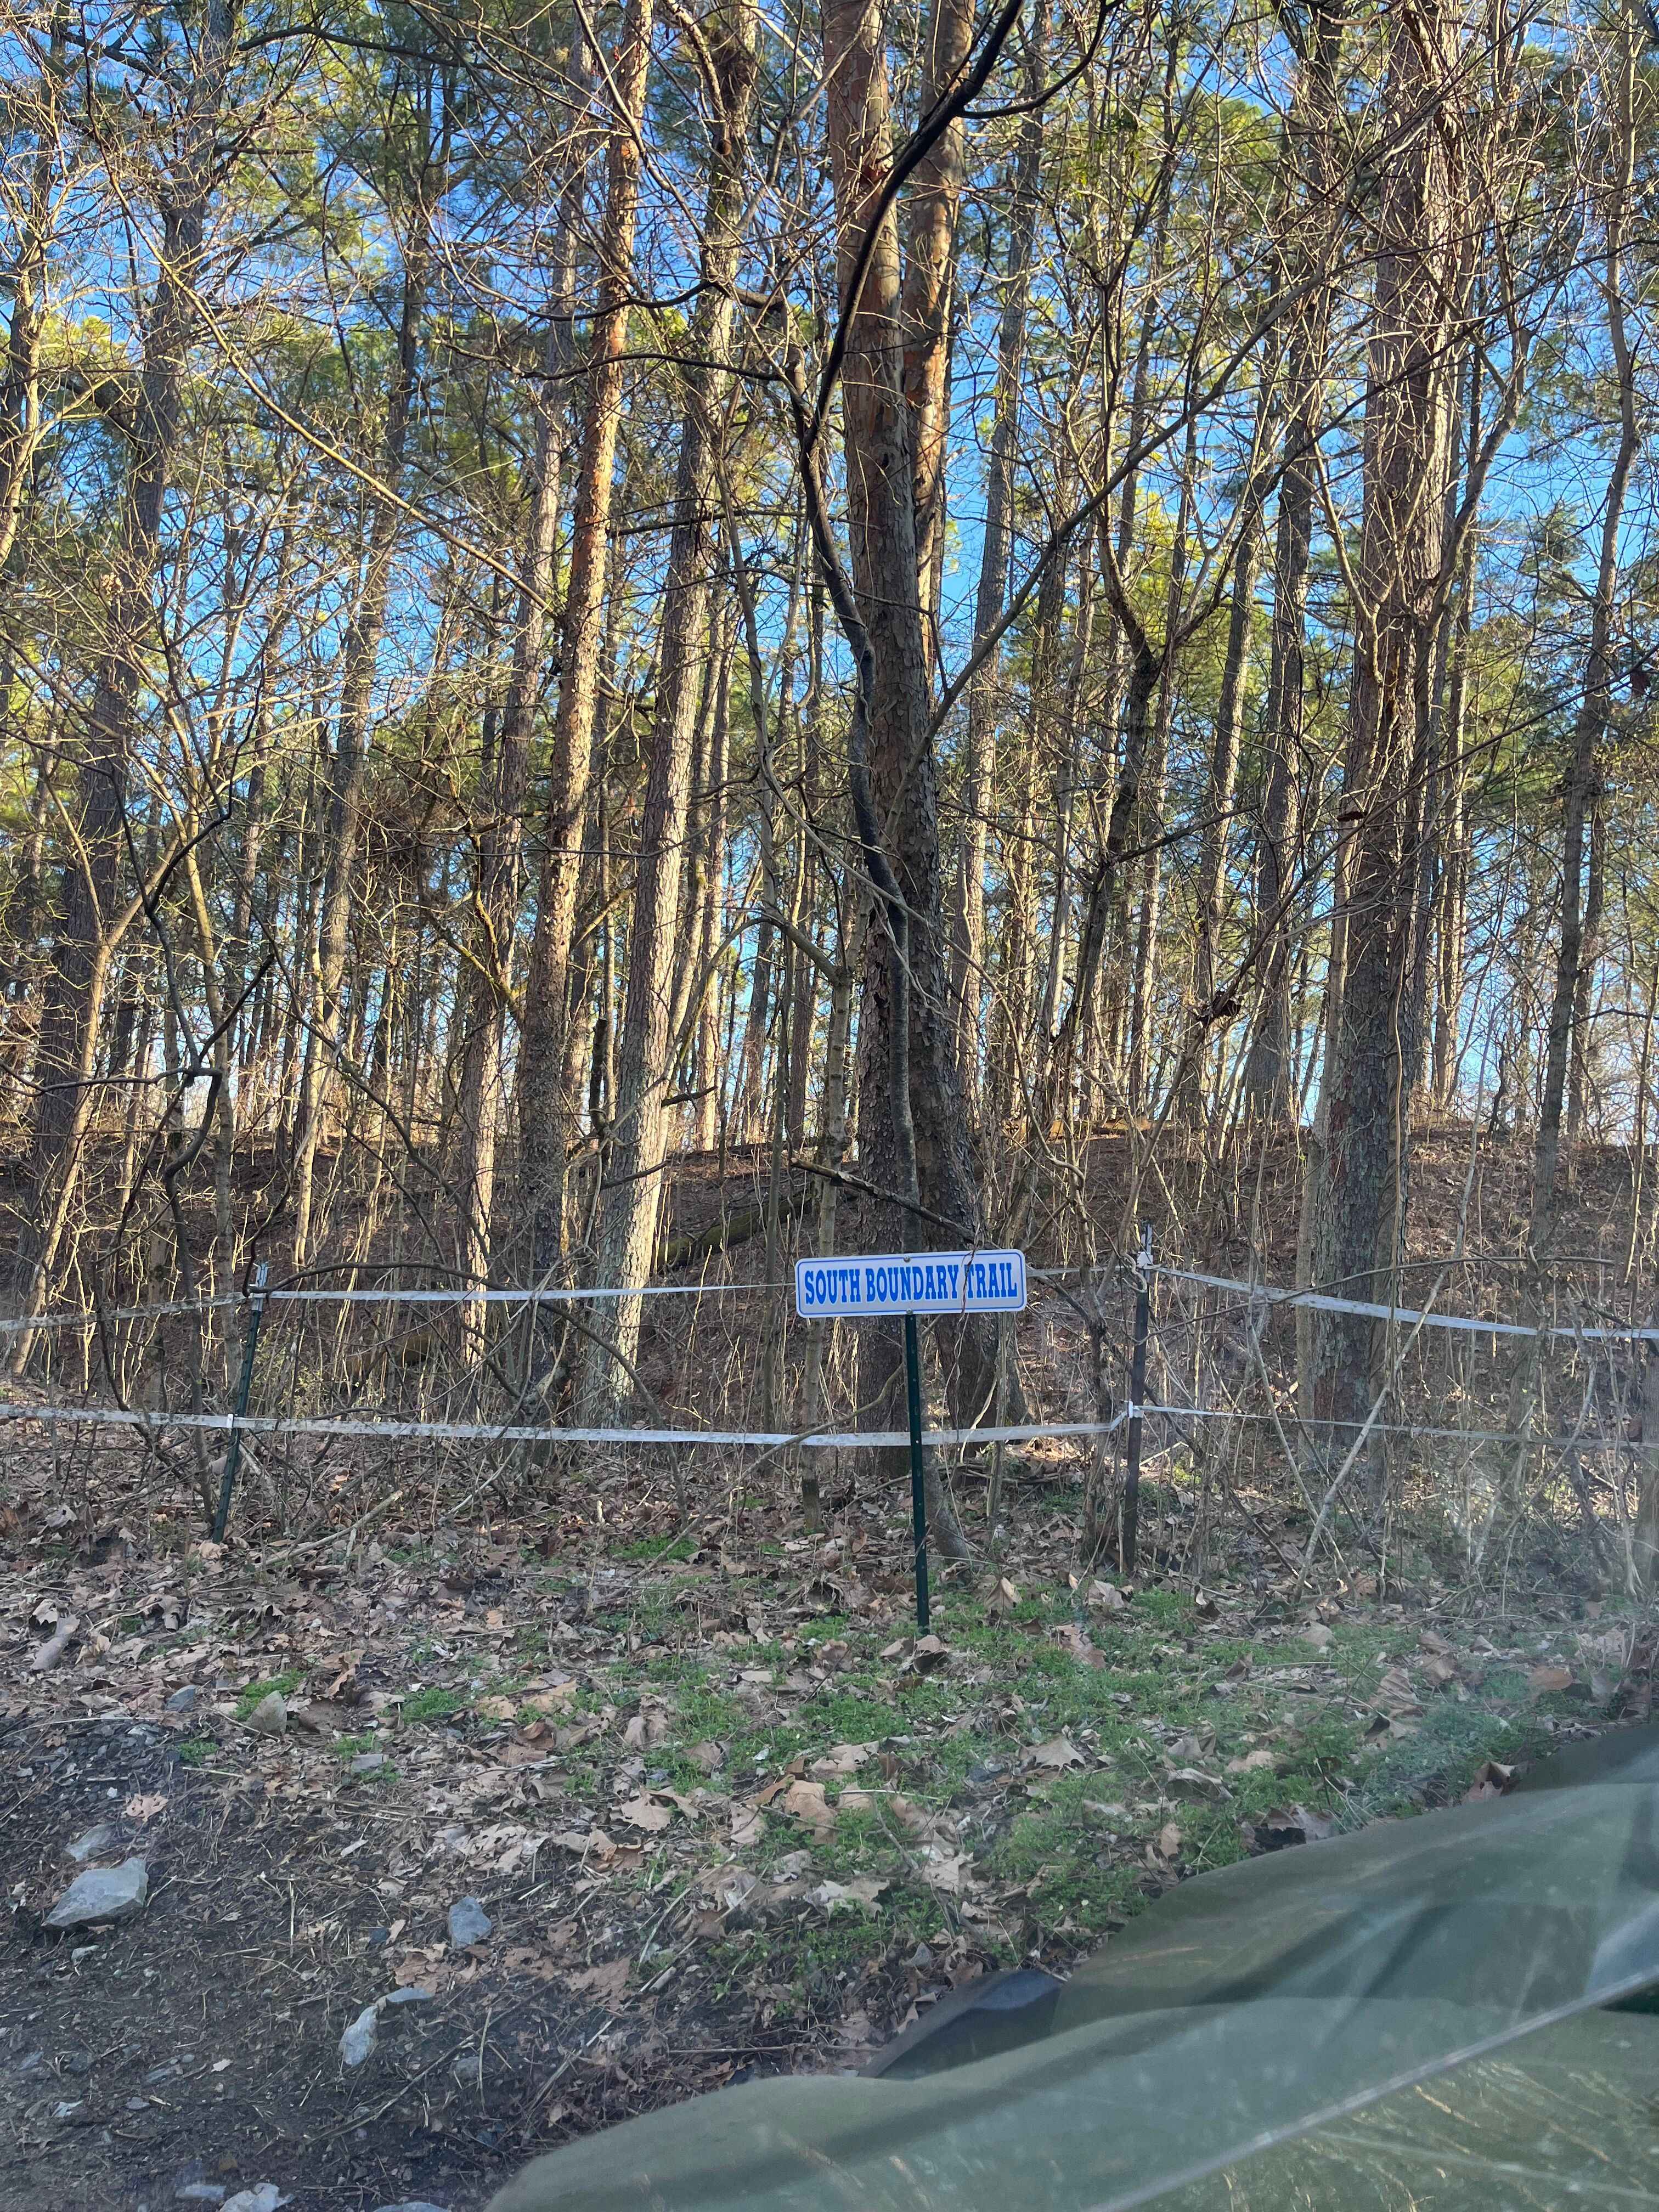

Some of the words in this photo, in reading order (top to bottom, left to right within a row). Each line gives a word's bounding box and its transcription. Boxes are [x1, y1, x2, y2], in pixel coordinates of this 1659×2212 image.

[804, 1269, 861, 1305] SOUTH
[865, 1265, 959, 1302] BOUNDARY
[964, 1262, 1018, 1299] TRAIL
